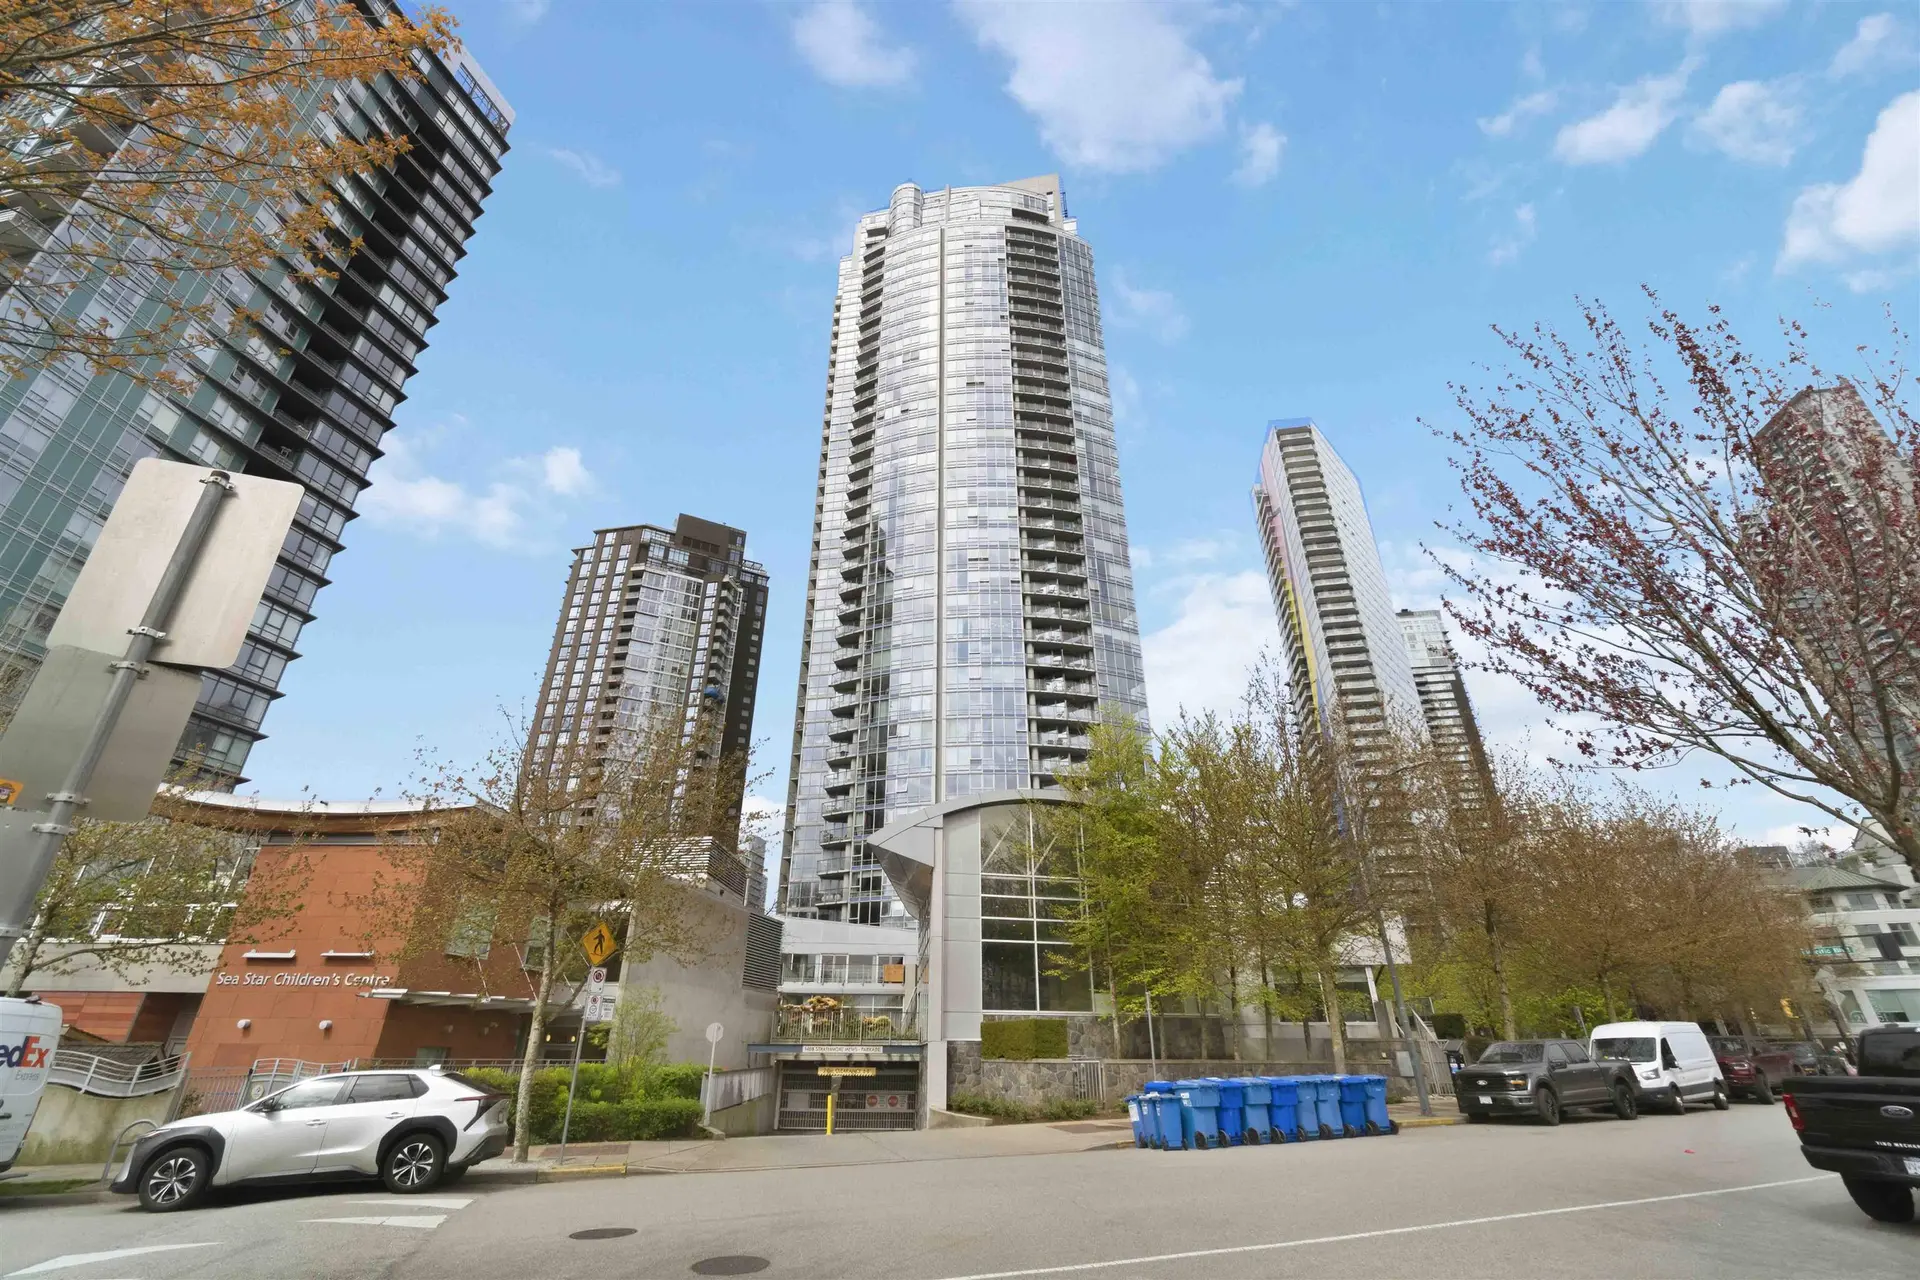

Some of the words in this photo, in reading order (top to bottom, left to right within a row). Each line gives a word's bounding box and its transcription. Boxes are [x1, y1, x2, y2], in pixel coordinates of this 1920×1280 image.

[215, 972, 240, 985] Sea
[242, 972, 271, 985] Star
[273, 972, 341, 986] Children's
[344, 973, 390, 986] Centre
[0, 1035, 50, 1068] edEx
